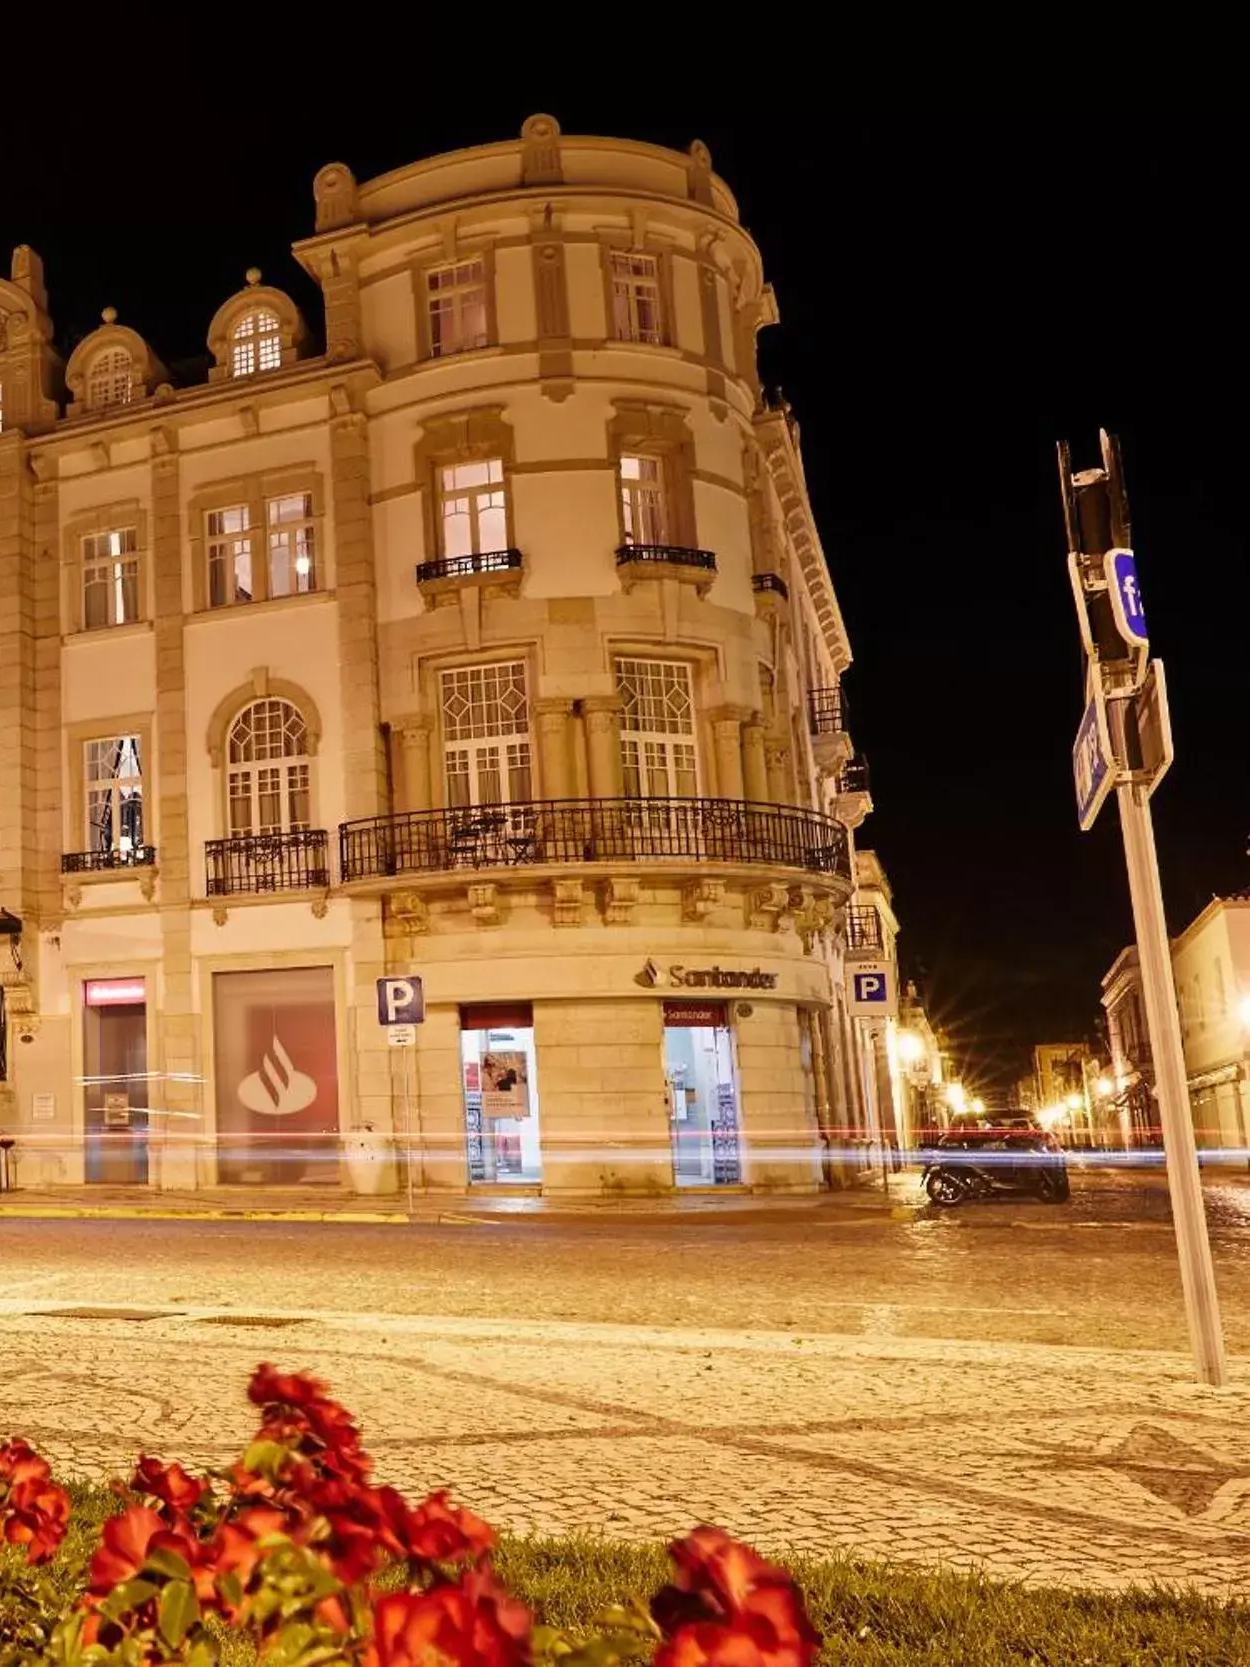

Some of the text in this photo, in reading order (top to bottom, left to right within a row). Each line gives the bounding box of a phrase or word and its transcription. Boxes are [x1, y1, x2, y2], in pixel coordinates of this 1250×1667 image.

[669, 965, 779, 989] Santander
[861, 977, 880, 999] P
[386, 981, 414, 1021] P
